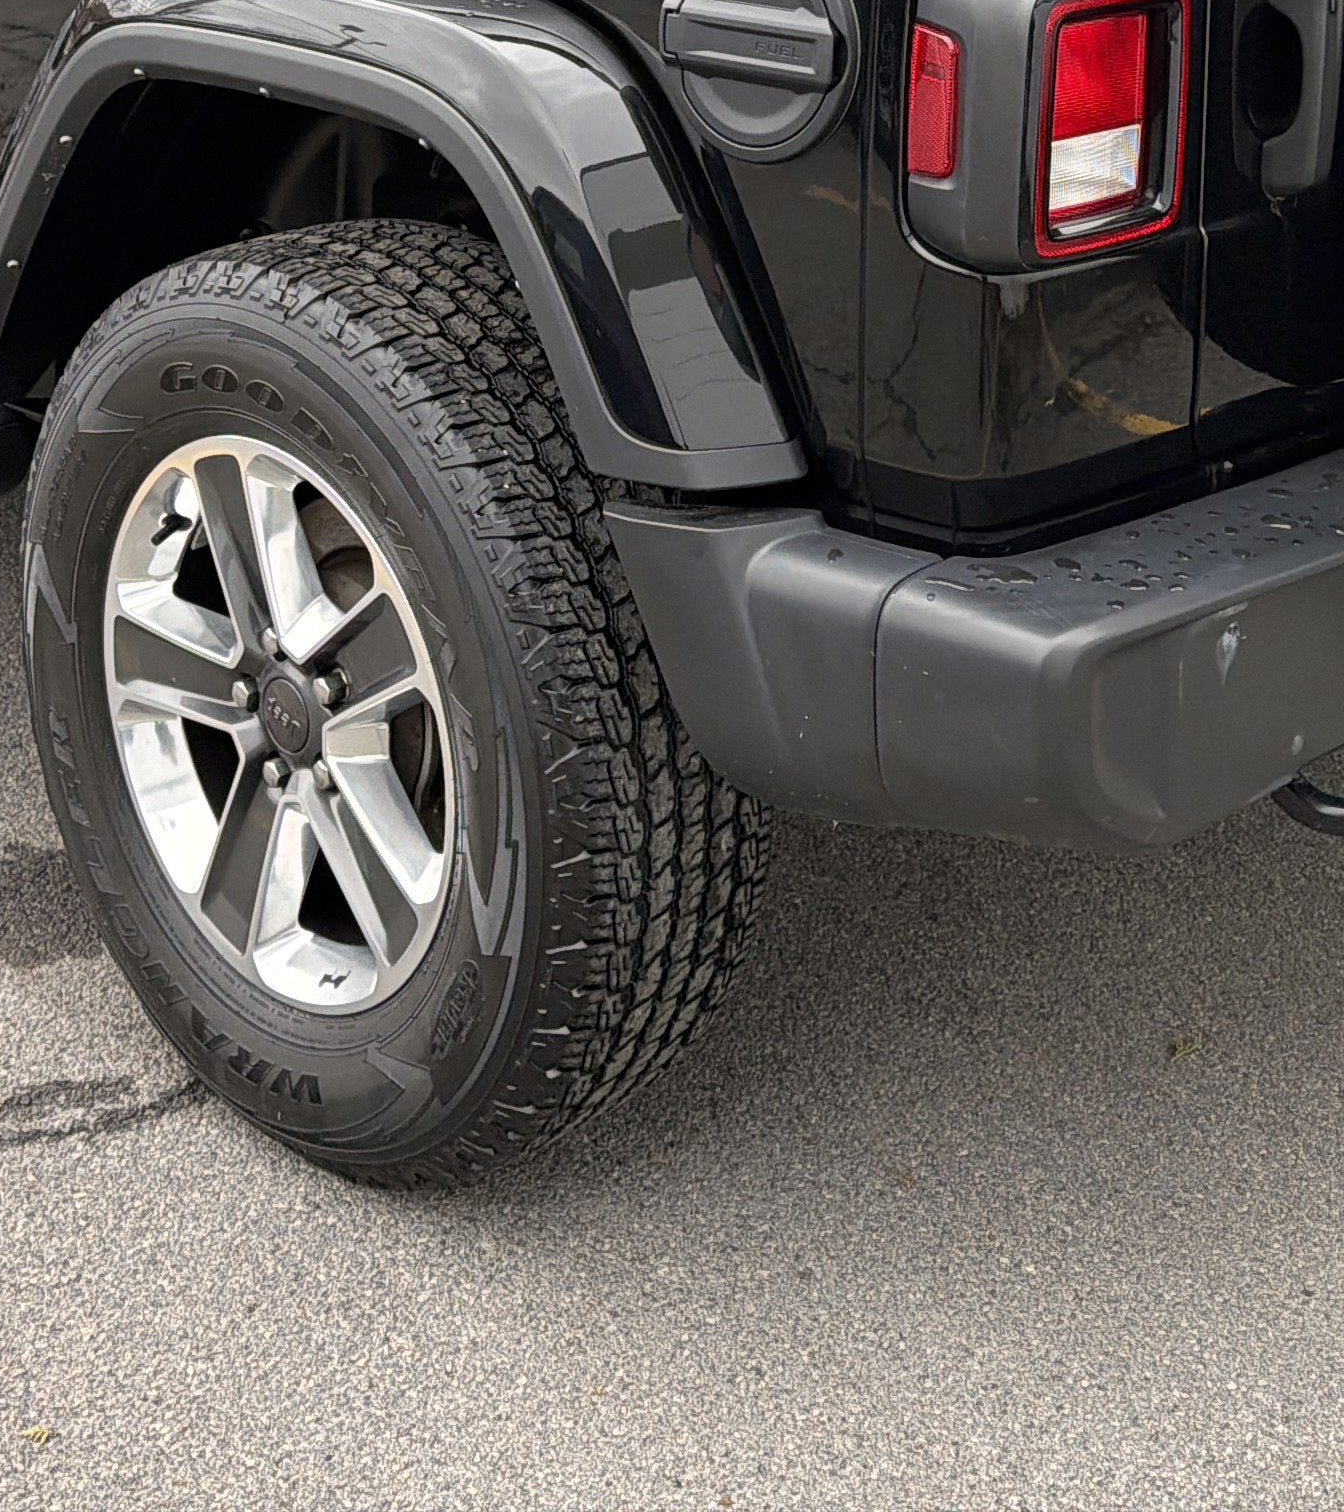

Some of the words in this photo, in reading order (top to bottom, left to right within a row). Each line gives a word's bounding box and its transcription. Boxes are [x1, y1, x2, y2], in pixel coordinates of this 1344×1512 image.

[755, 41, 802, 59] FUEL
[160, 361, 479, 772] GOODYEAR
[48, 707, 323, 1106] WRANGLER
